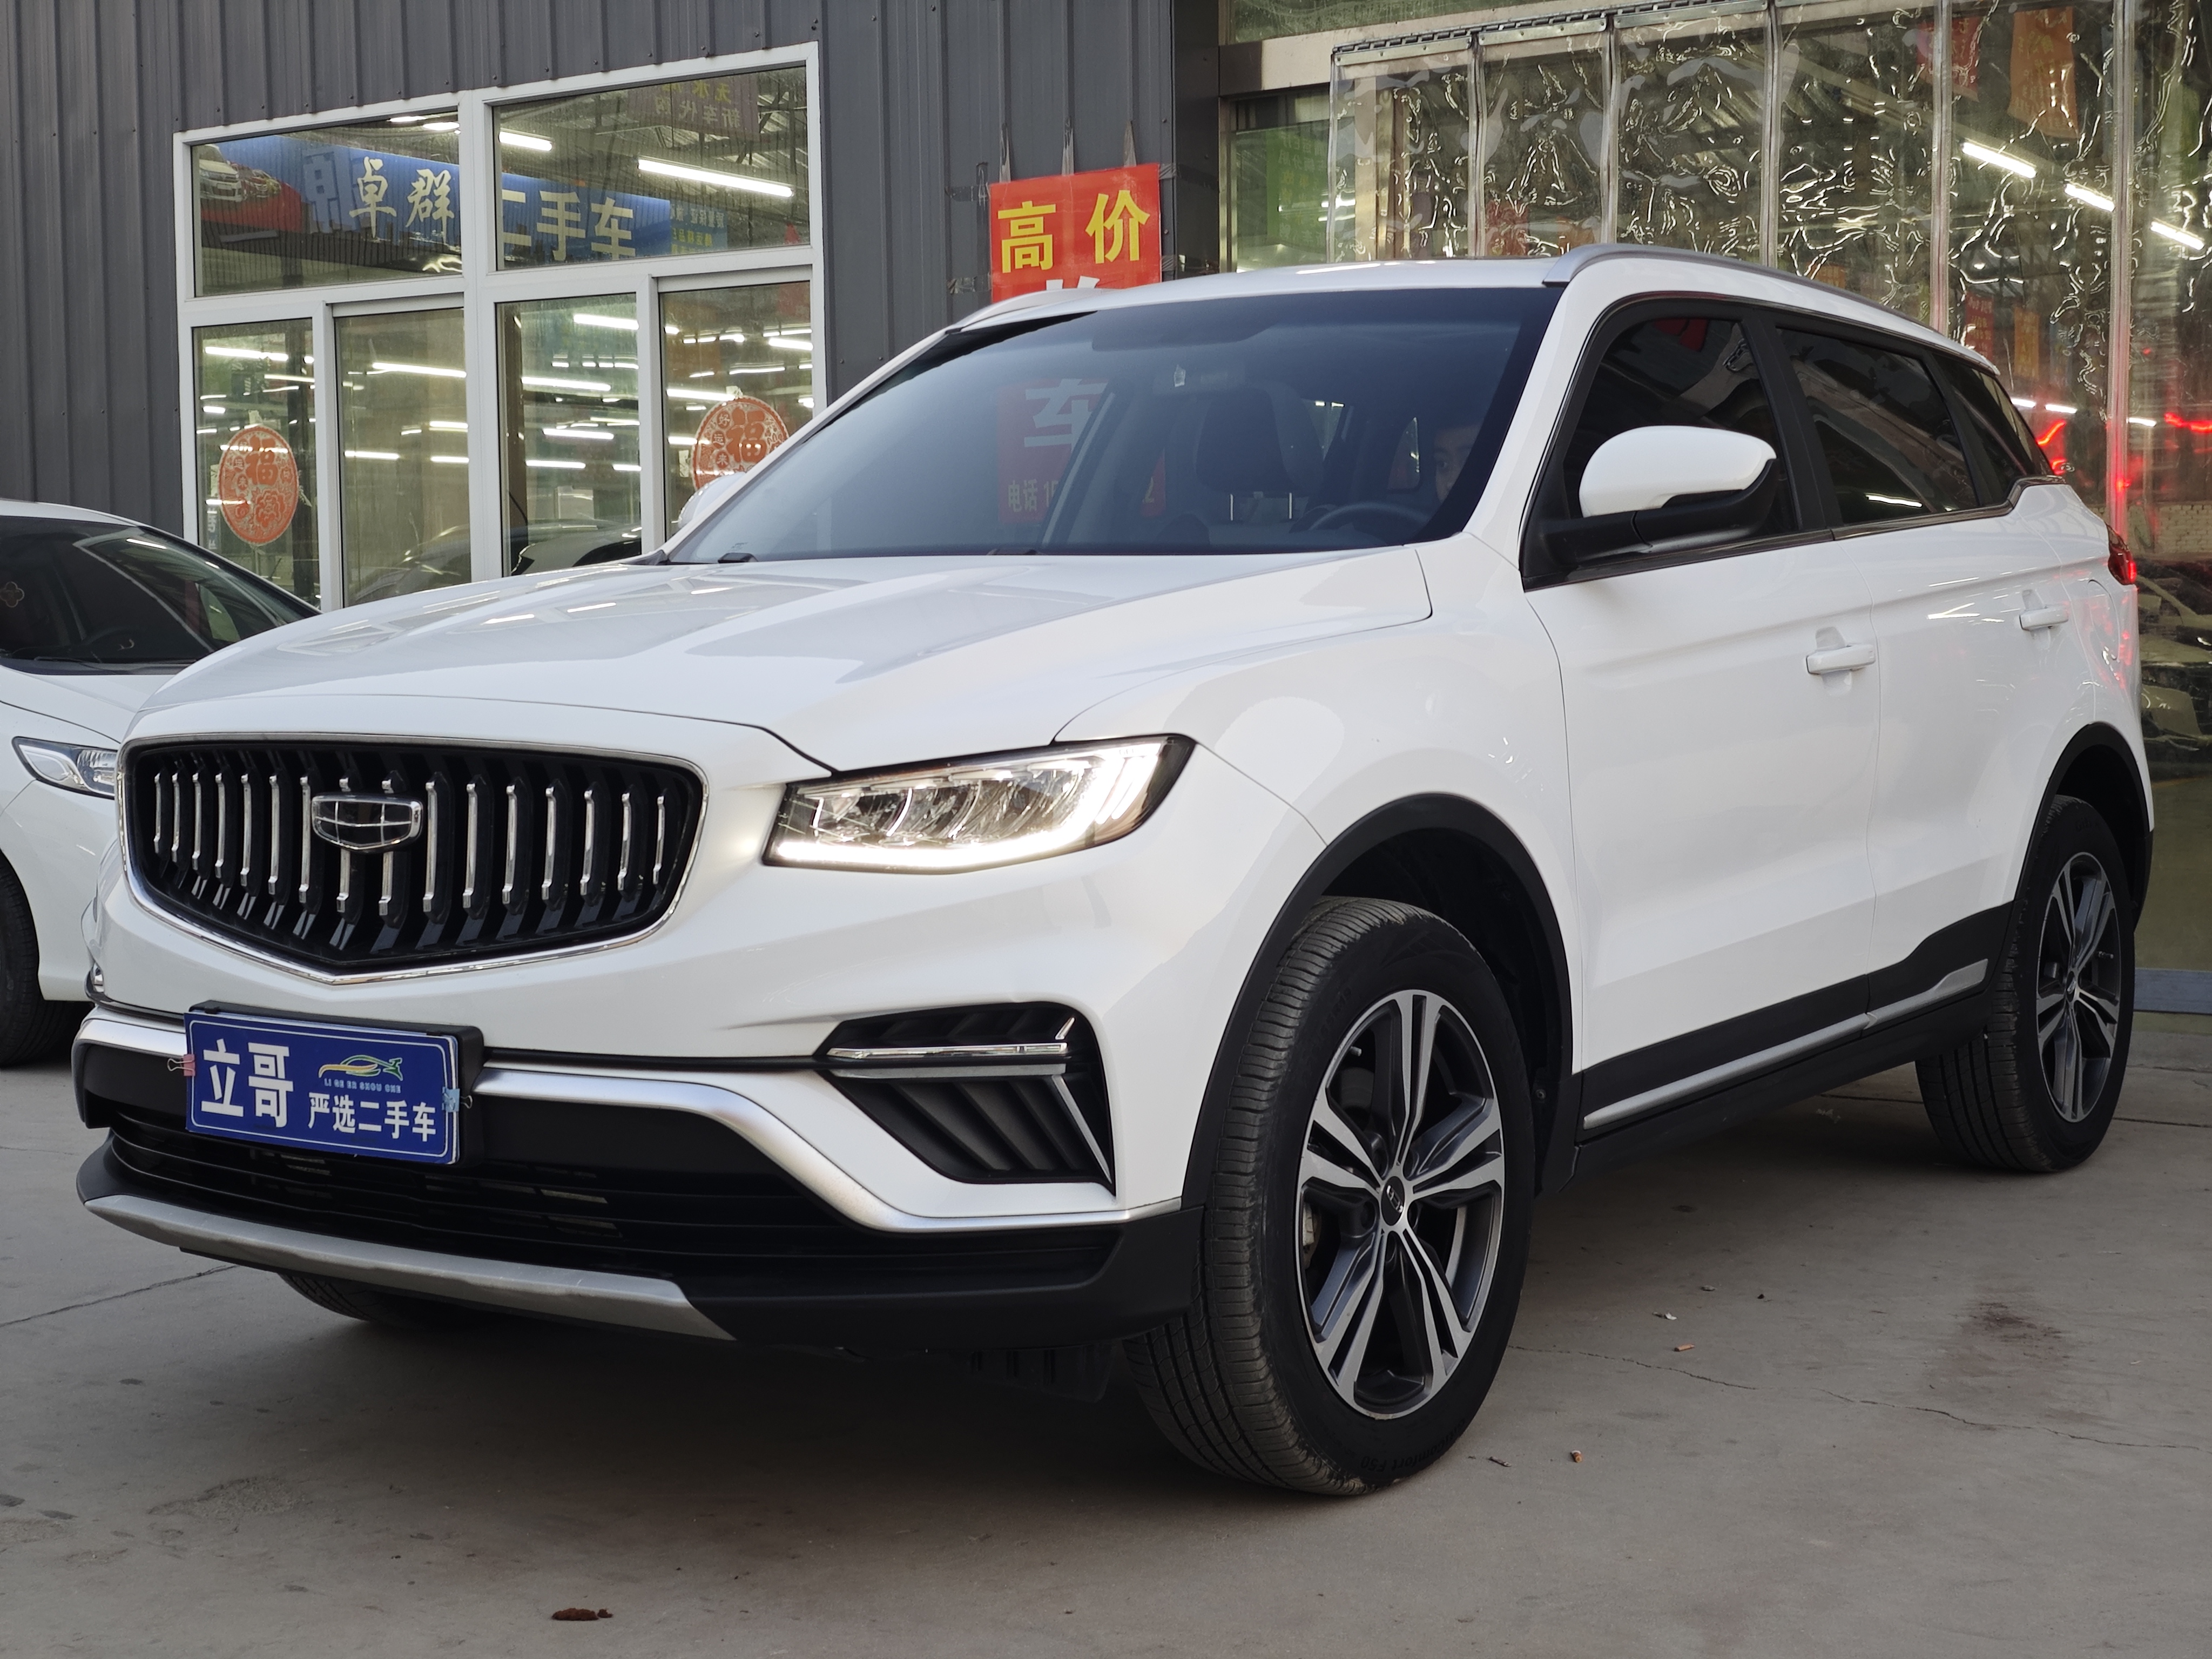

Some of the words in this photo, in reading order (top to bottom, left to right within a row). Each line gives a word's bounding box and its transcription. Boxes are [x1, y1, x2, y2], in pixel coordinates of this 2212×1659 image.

[349, 156, 455, 244] 卓群
[502, 189, 636, 261] 二手车
[997, 190, 1150, 273] 高价
[726, 407, 767, 463] 福
[1024, 379, 1108, 451] 车
[245, 435, 279, 486] 福
[1008, 479, 1038, 512] 电话
[201, 1038, 293, 1128] 立哥
[324, 1078, 332, 1087] LI
[334, 1079, 345, 1088] GE
[347, 1081, 358, 1090] ER
[359, 1082, 382, 1092] SHOU
[385, 1084, 401, 1094] CHE
[308, 1091, 436, 1142] 严选二手车
